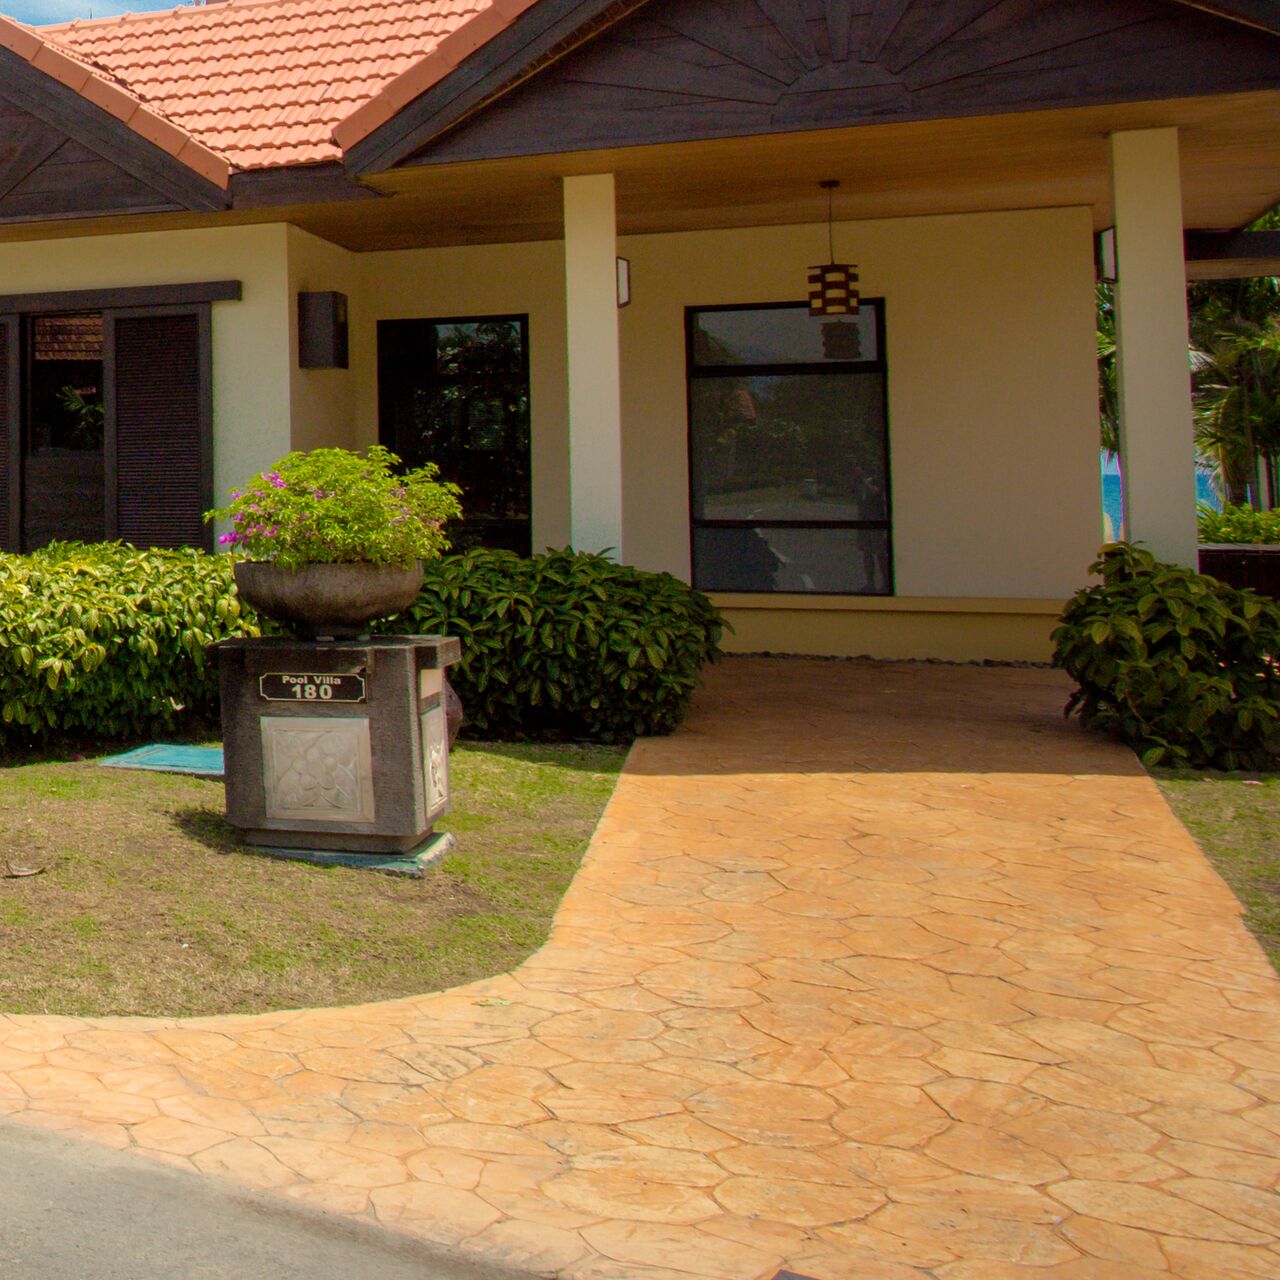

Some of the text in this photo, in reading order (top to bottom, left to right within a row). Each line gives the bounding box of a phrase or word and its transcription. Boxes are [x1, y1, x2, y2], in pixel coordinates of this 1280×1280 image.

[282, 675, 342, 685] Pool Villa
[291, 685, 333, 699] 180
